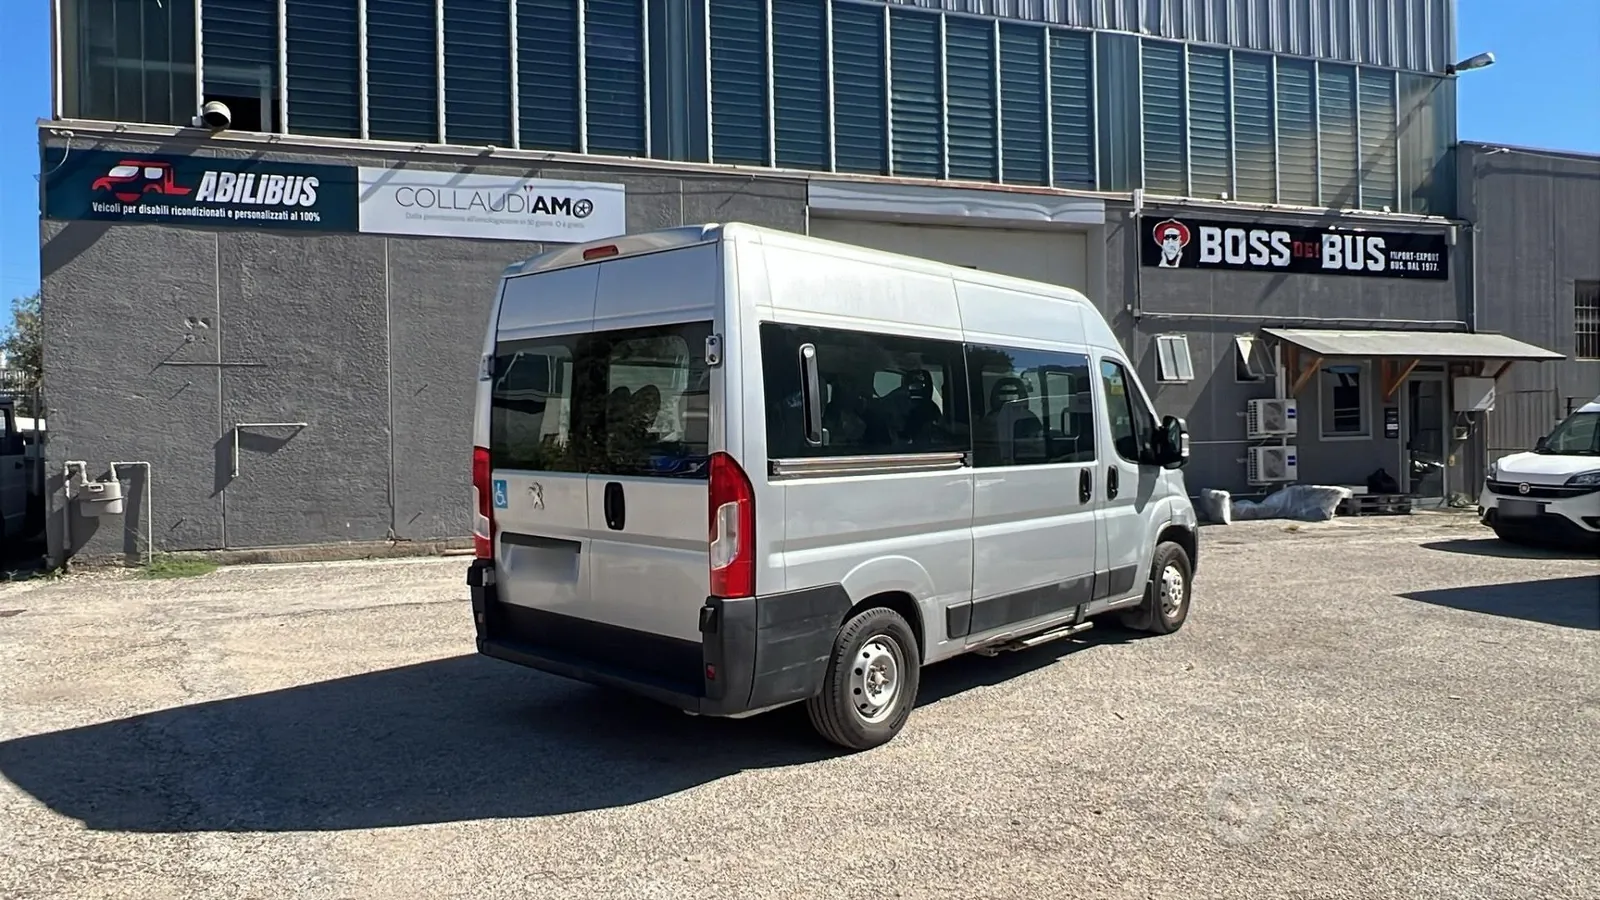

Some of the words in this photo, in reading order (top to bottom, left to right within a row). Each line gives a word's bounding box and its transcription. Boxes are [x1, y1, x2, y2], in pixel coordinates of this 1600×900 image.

[195, 171, 320, 207] ABILIBUS
[92, 201, 121, 213] Veicoli
[123, 205, 137, 216] per
[138, 203, 169, 215] disabili
[171, 206, 226, 218] ricondizionati
[227, 210, 233, 218] e
[235, 209, 289, 221] personalizzati
[290, 211, 298, 221] al
[299, 211, 321, 222] 100%
[1199, 226, 1291, 267] BOSS
[1321, 234, 1386, 272] BUS
[1390, 261, 1406, 270] BUS.
[1407, 261, 1420, 271] DAL
